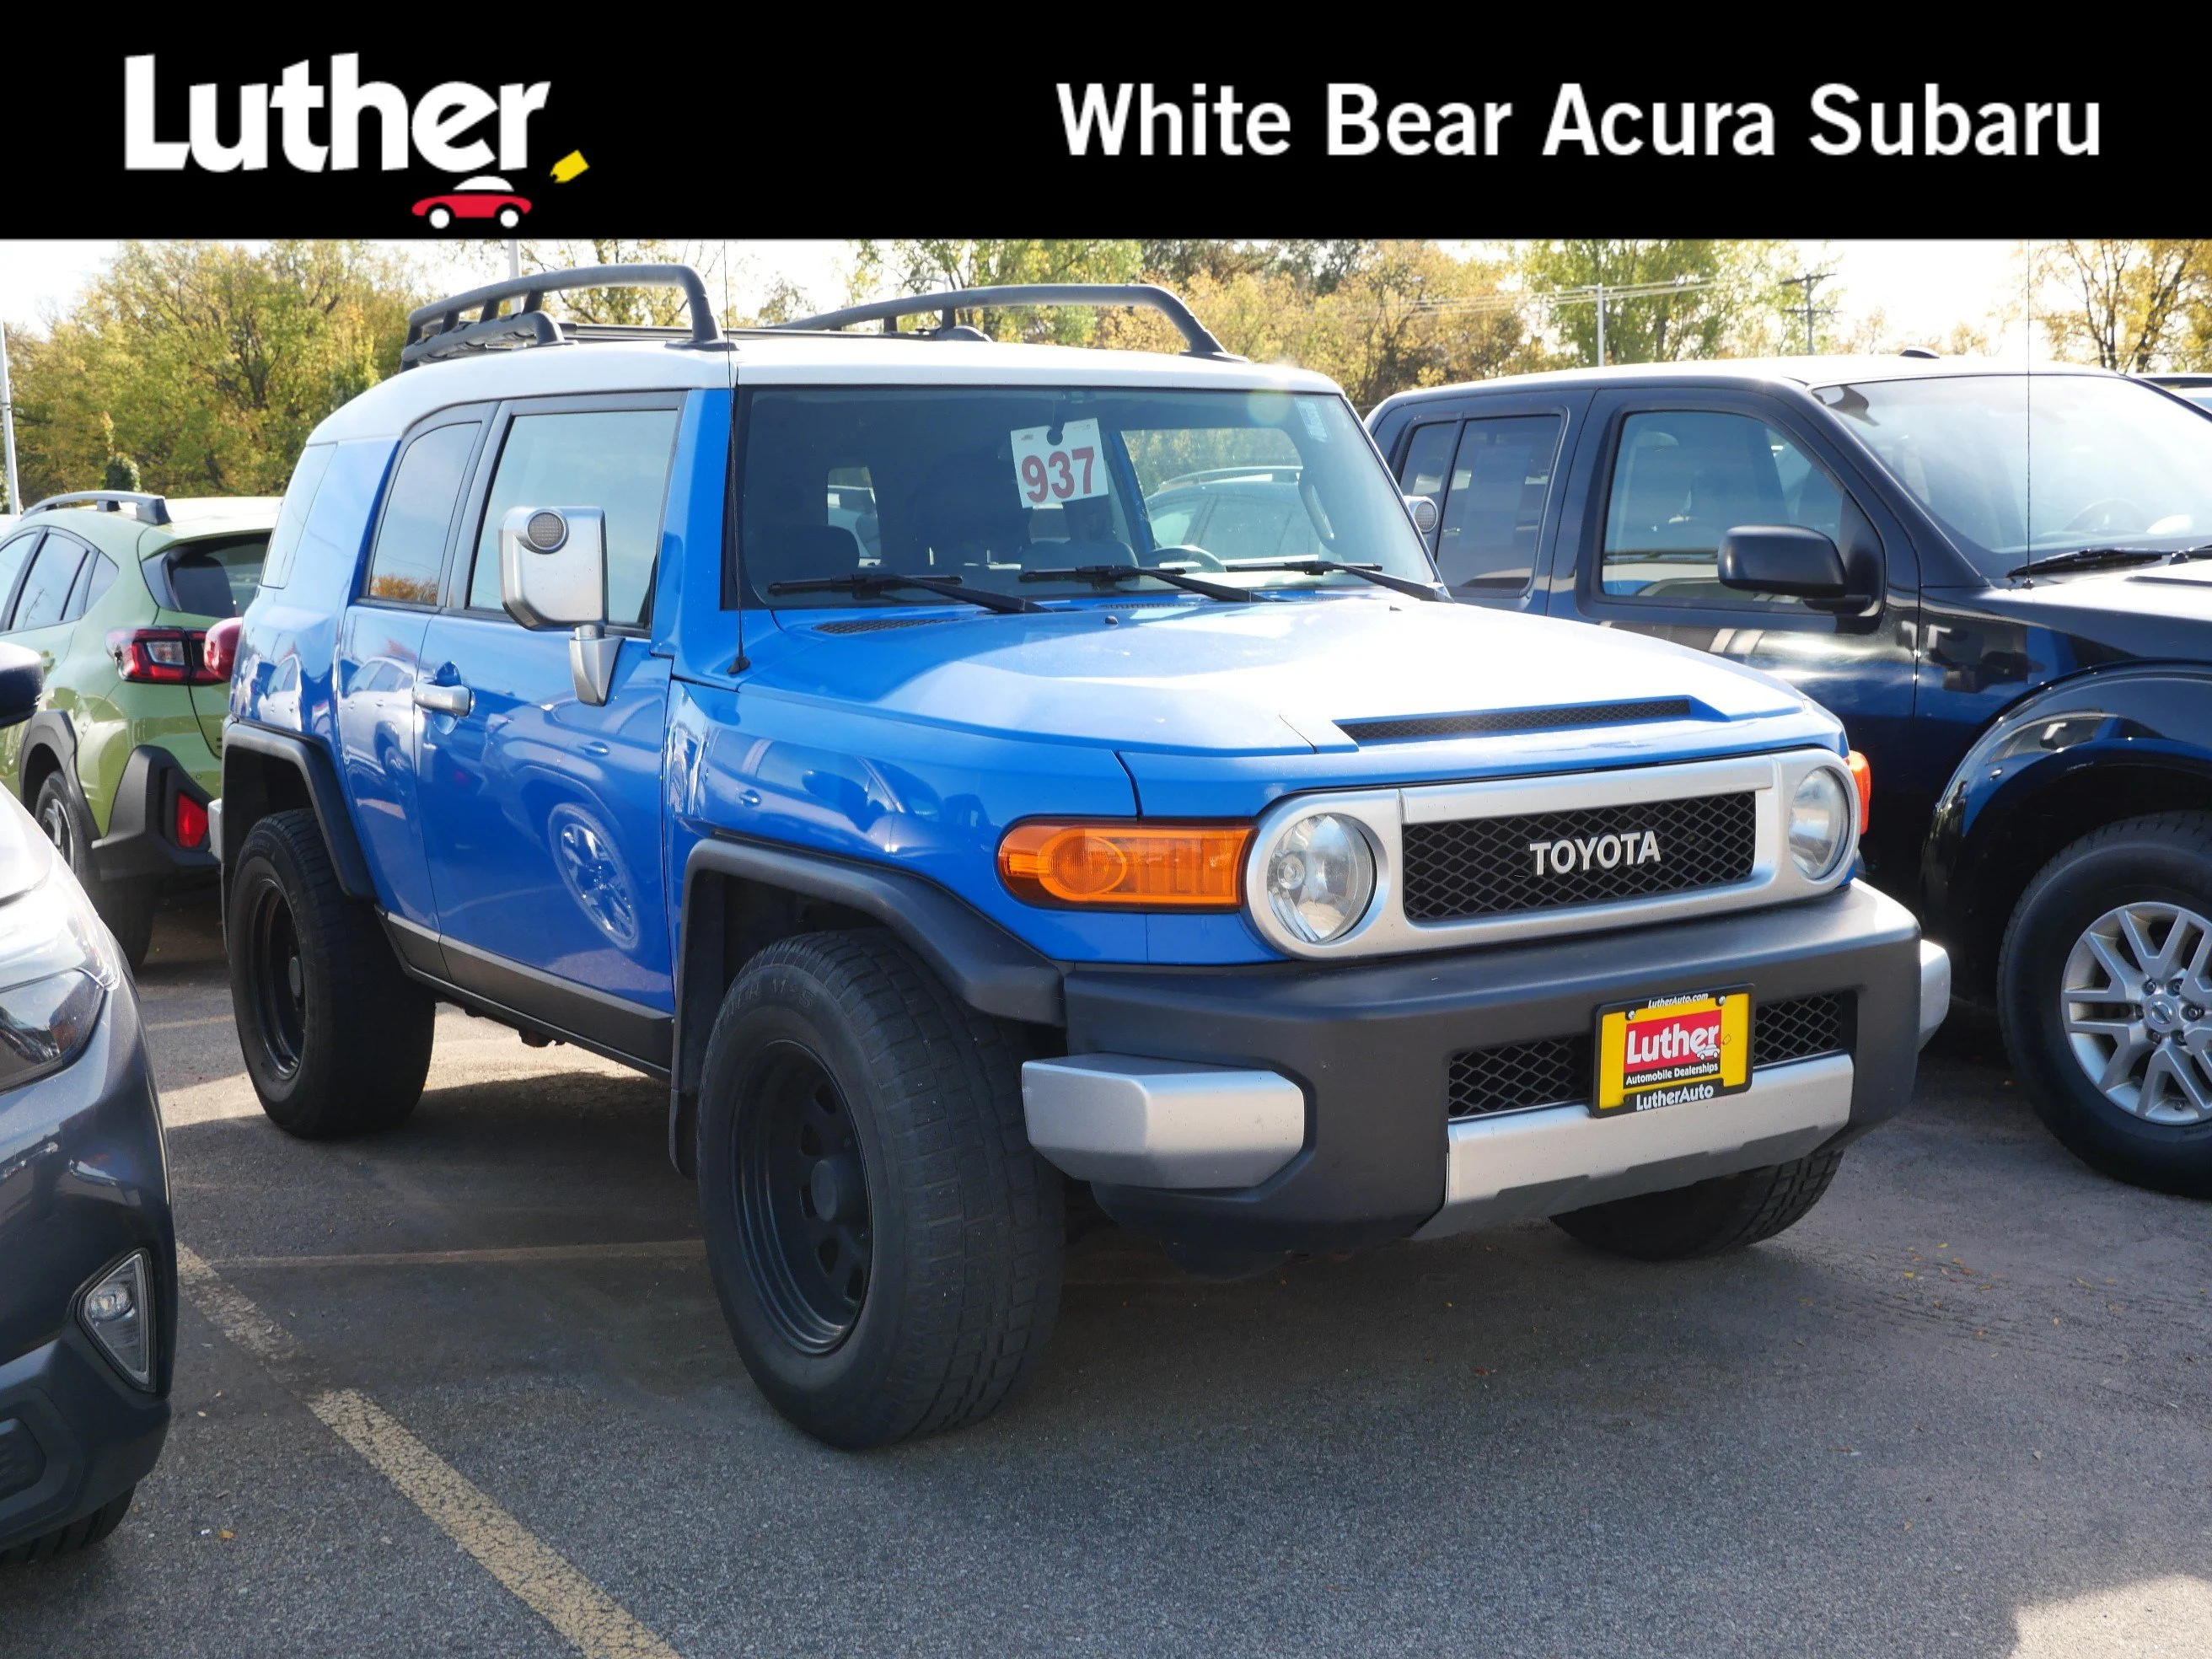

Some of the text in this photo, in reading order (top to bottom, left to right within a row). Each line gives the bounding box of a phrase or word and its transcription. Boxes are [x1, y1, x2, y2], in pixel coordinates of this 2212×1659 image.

[1021, 446, 1095, 503] 937
[1529, 830, 1662, 876] TOYOTA
[1647, 992, 1709, 1009] LutherAuto.com
[1627, 1023, 1720, 1065] Luther
[1625, 1063, 1719, 1086] Automobile Dealerships
[1635, 1083, 1715, 1112] LutherAuto
